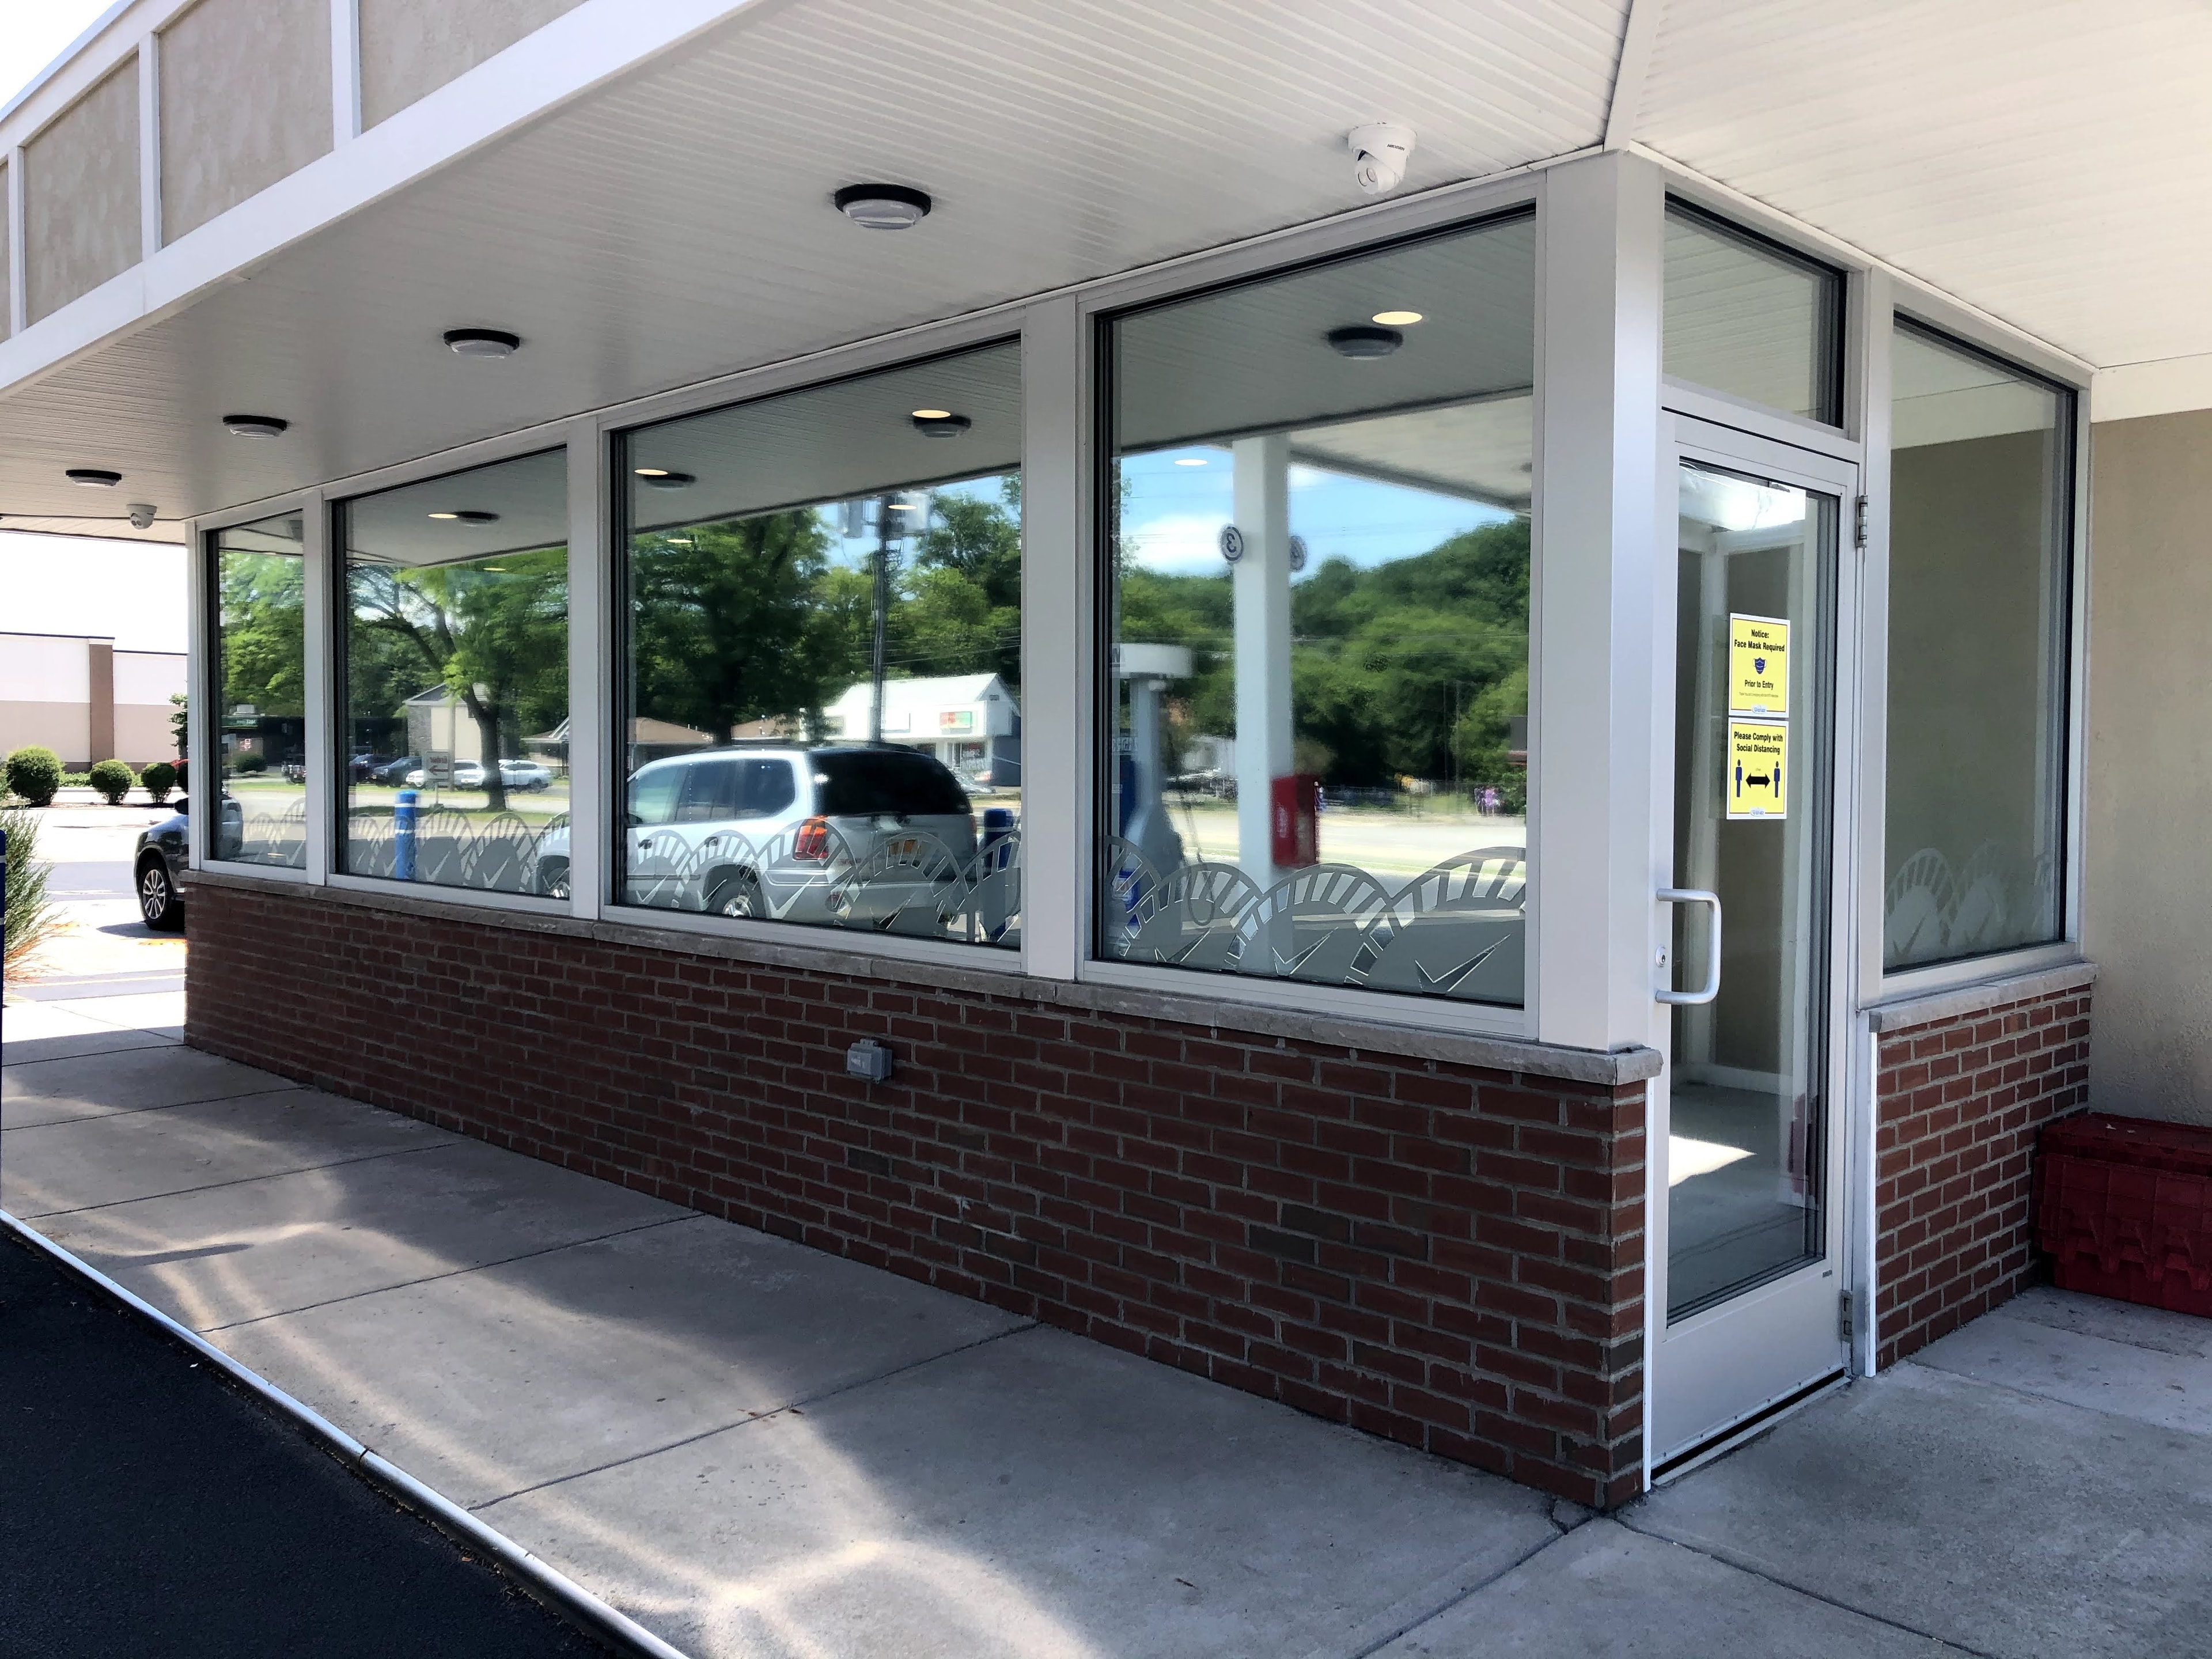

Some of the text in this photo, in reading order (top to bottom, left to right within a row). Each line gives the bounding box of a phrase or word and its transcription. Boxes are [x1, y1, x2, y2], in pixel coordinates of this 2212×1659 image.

[1751, 629, 1769, 638] Notice:
[1734, 639, 1785, 652] Face Mask Required
[1745, 680, 1755, 688] Prior
[1762, 681, 1774, 690] Entry
[1734, 731, 1783, 743] Please Comply with
[1737, 744, 1780, 755] Social Distancing
